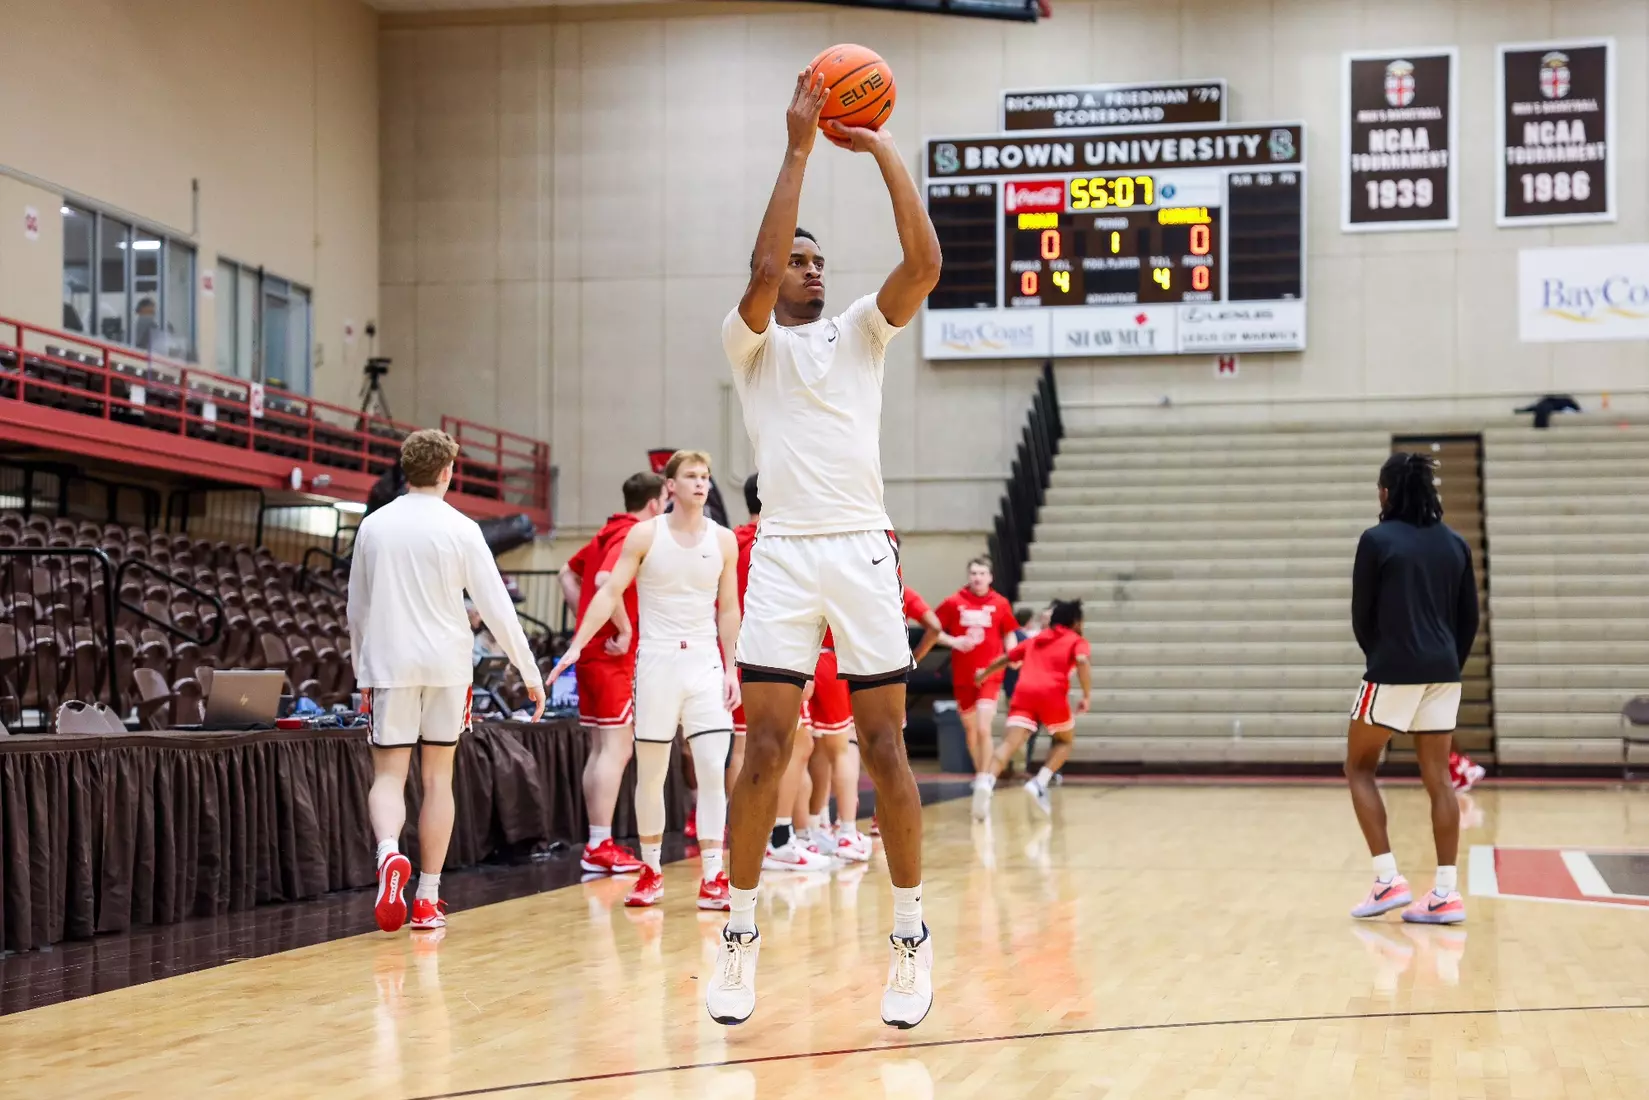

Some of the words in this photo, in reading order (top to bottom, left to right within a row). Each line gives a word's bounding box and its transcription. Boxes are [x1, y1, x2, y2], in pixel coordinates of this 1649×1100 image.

[839, 72, 885, 108] ELITE
[1005, 93, 1079, 112] RICHARD
[1104, 88, 1189, 108] FRIEDMAN
[1053, 106, 1166, 127] SCOREBOARD
[1368, 126, 1430, 154] NCAA
[1523, 119, 1587, 146] NCAA
[964, 144, 1075, 170] BROWN
[1084, 133, 1262, 166] UNIVERSITY
[1351, 149, 1448, 172] TOURNAMENT
[1506, 140, 1606, 165] TOURNAMENT
[1069, 176, 1154, 210] 55:07
[1364, 178, 1434, 209] 1939
[1521, 170, 1591, 203] 1986
[1041, 229, 1061, 260] 0
[1110, 231, 1121, 254] 1
[1189, 224, 1211, 256] 0
[1021, 271, 1038, 296] 0
[1052, 271, 1070, 293] 4
[1153, 267, 1171, 290] 4
[1191, 265, 1210, 291] 0
